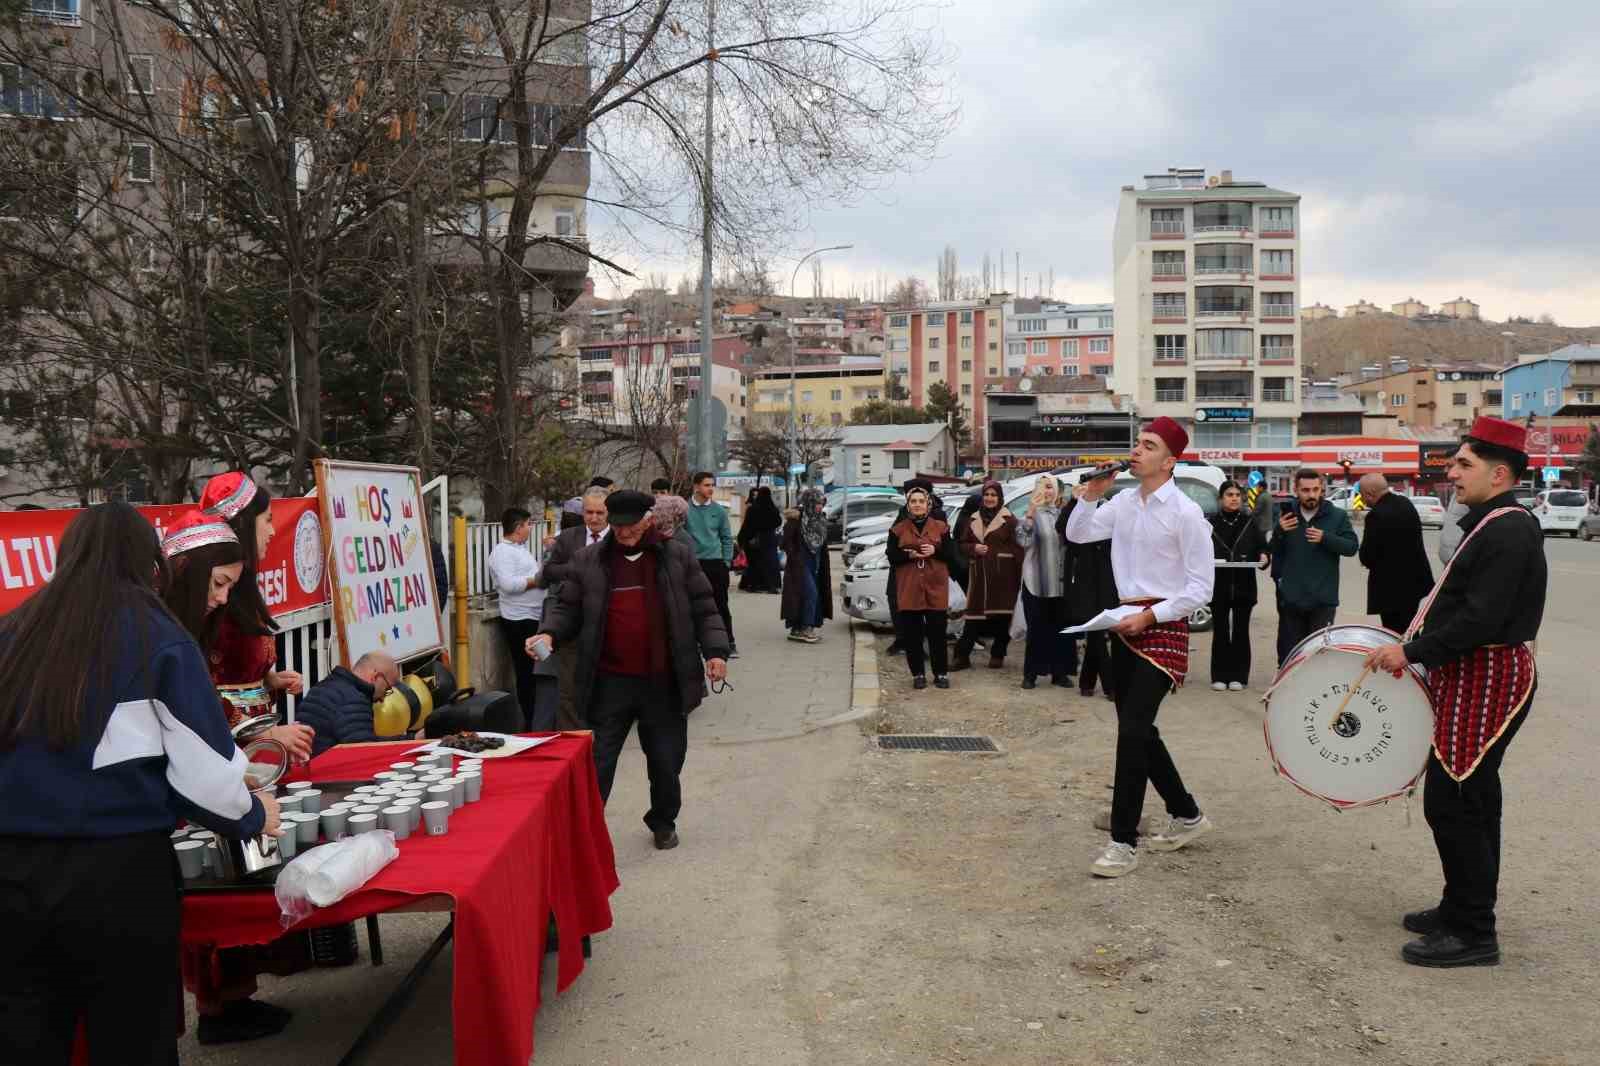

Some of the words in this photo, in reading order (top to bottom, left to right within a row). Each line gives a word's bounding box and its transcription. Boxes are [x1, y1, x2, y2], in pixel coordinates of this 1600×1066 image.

[1201, 451, 1241, 460] ECZANE
[355, 485, 392, 527] HOŞ
[341, 572, 428, 624] RAMAZAN
